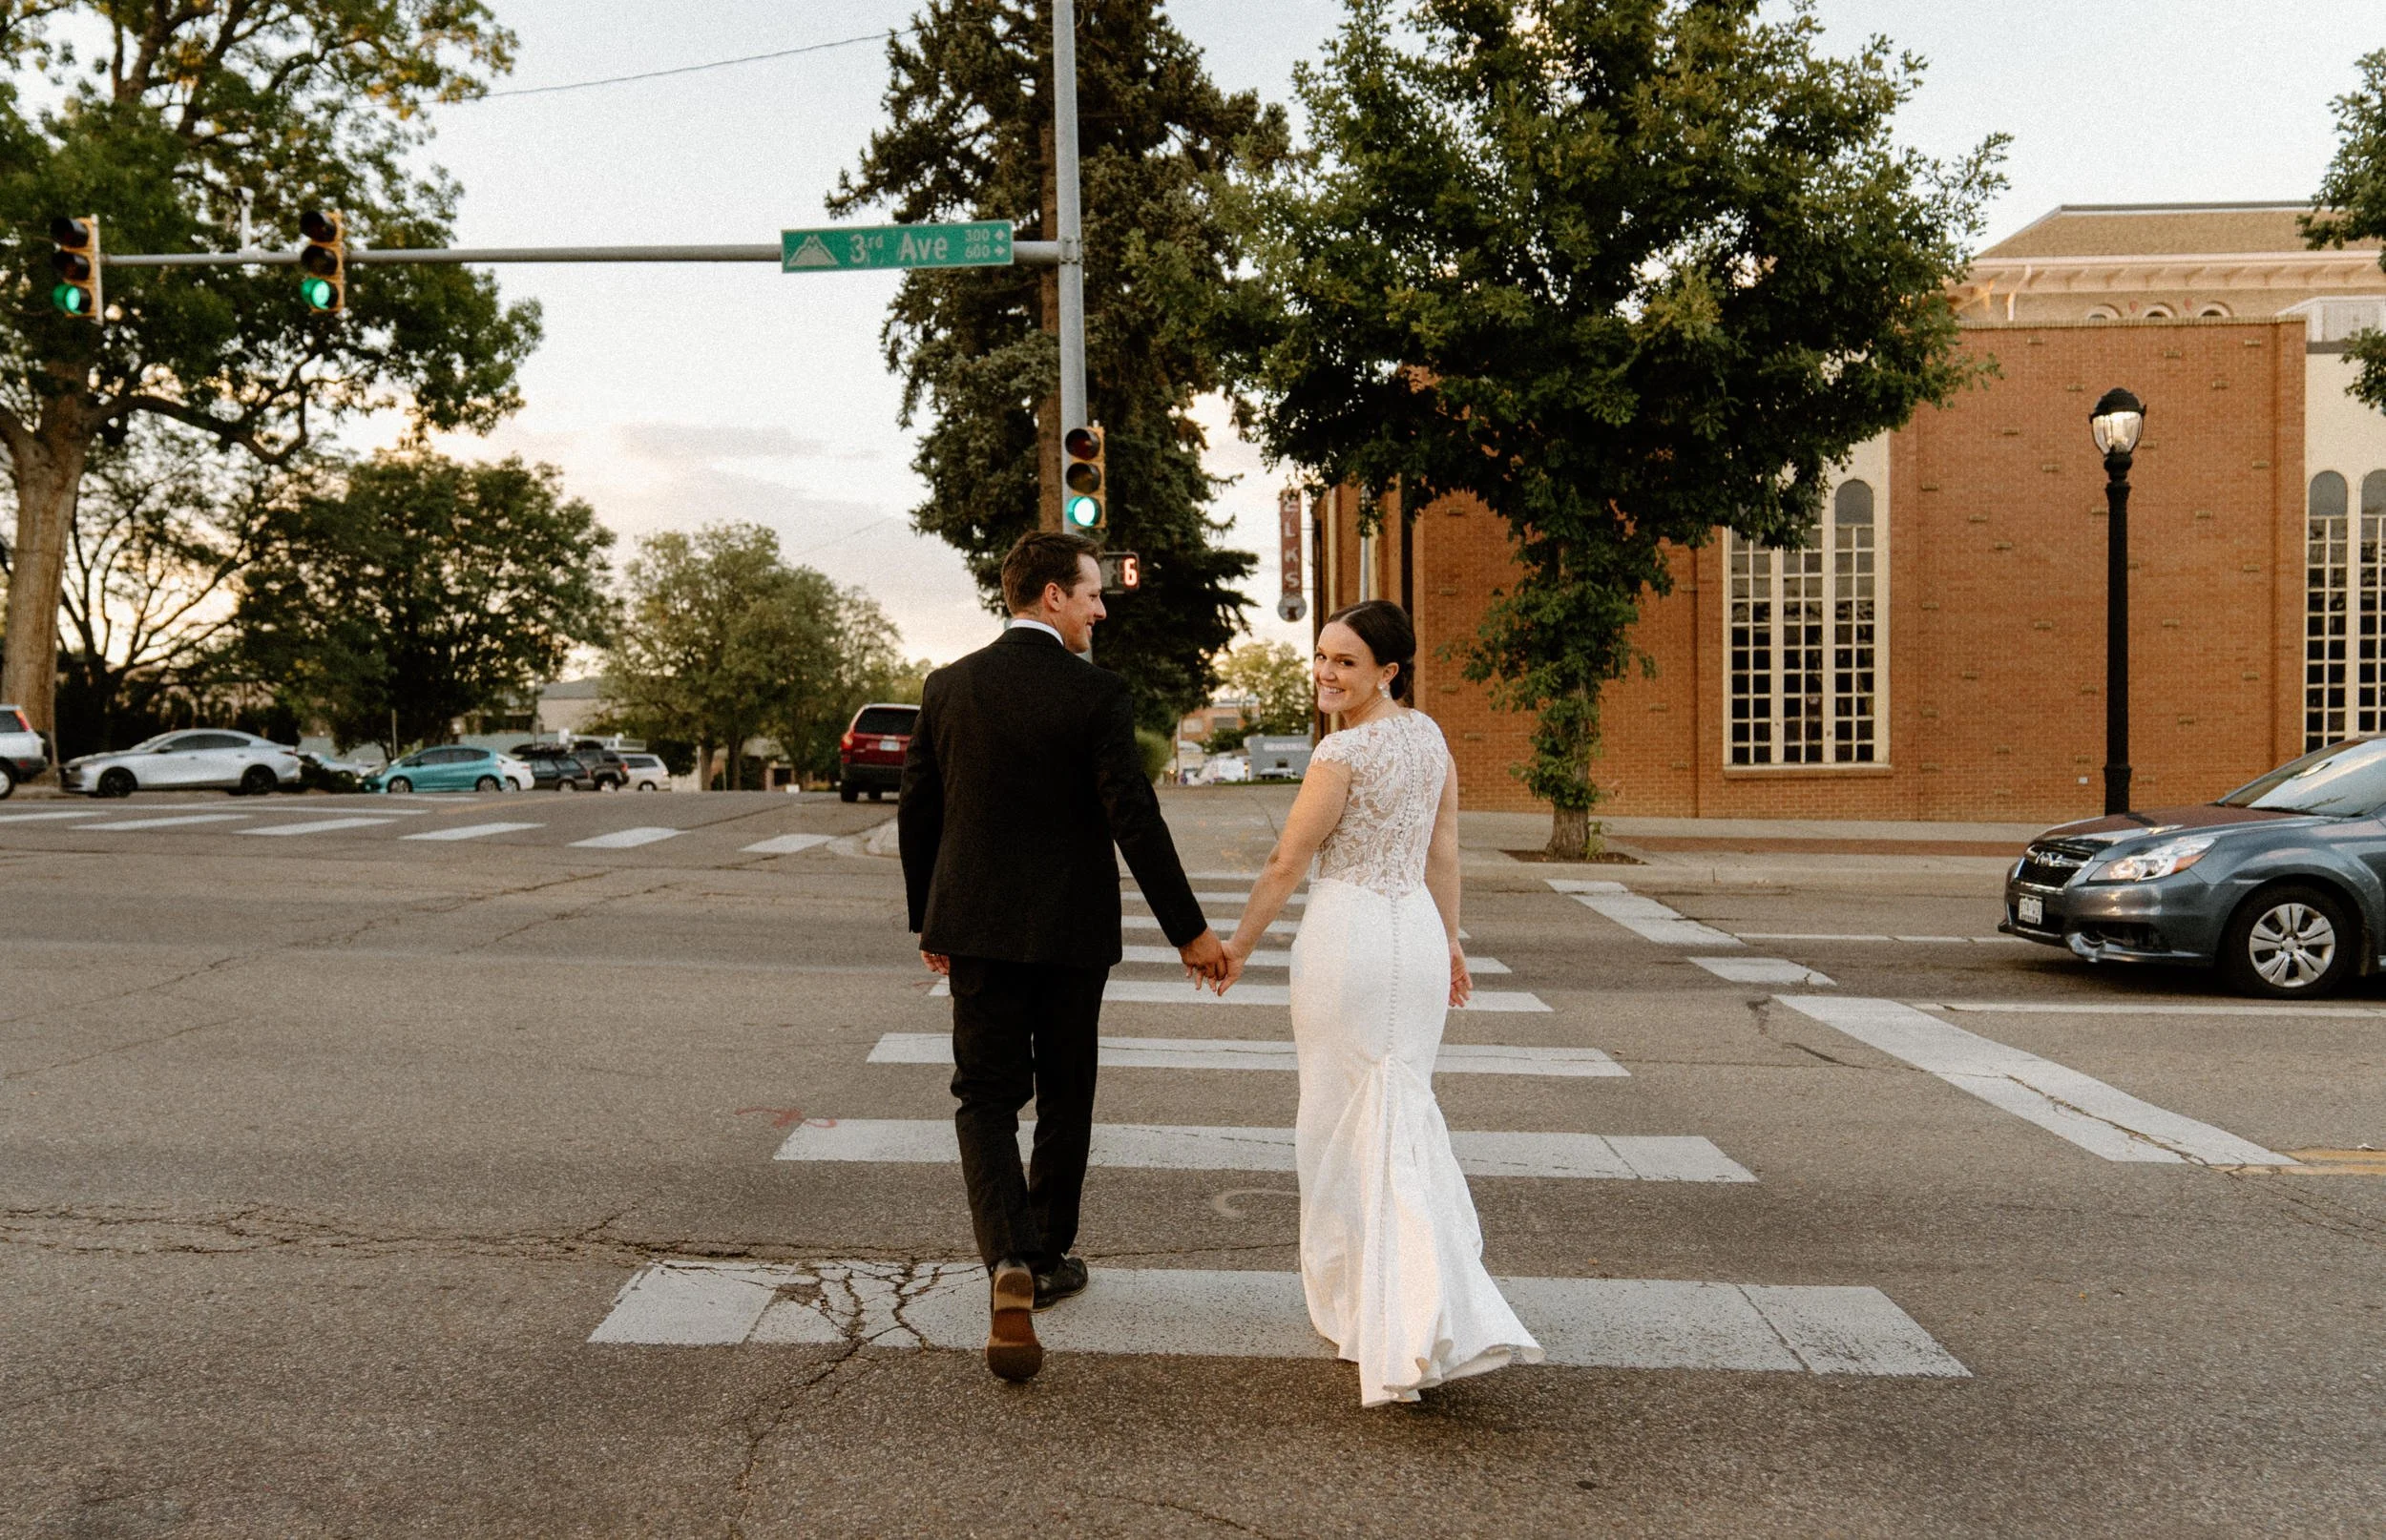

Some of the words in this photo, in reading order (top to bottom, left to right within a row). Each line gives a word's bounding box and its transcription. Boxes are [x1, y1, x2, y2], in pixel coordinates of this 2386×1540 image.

[964, 229, 990, 242] 300
[849, 234, 884, 264] 3rd
[898, 232, 948, 261] Ave
[964, 244, 991, 259] 600
[1123, 557, 1138, 587] 6
